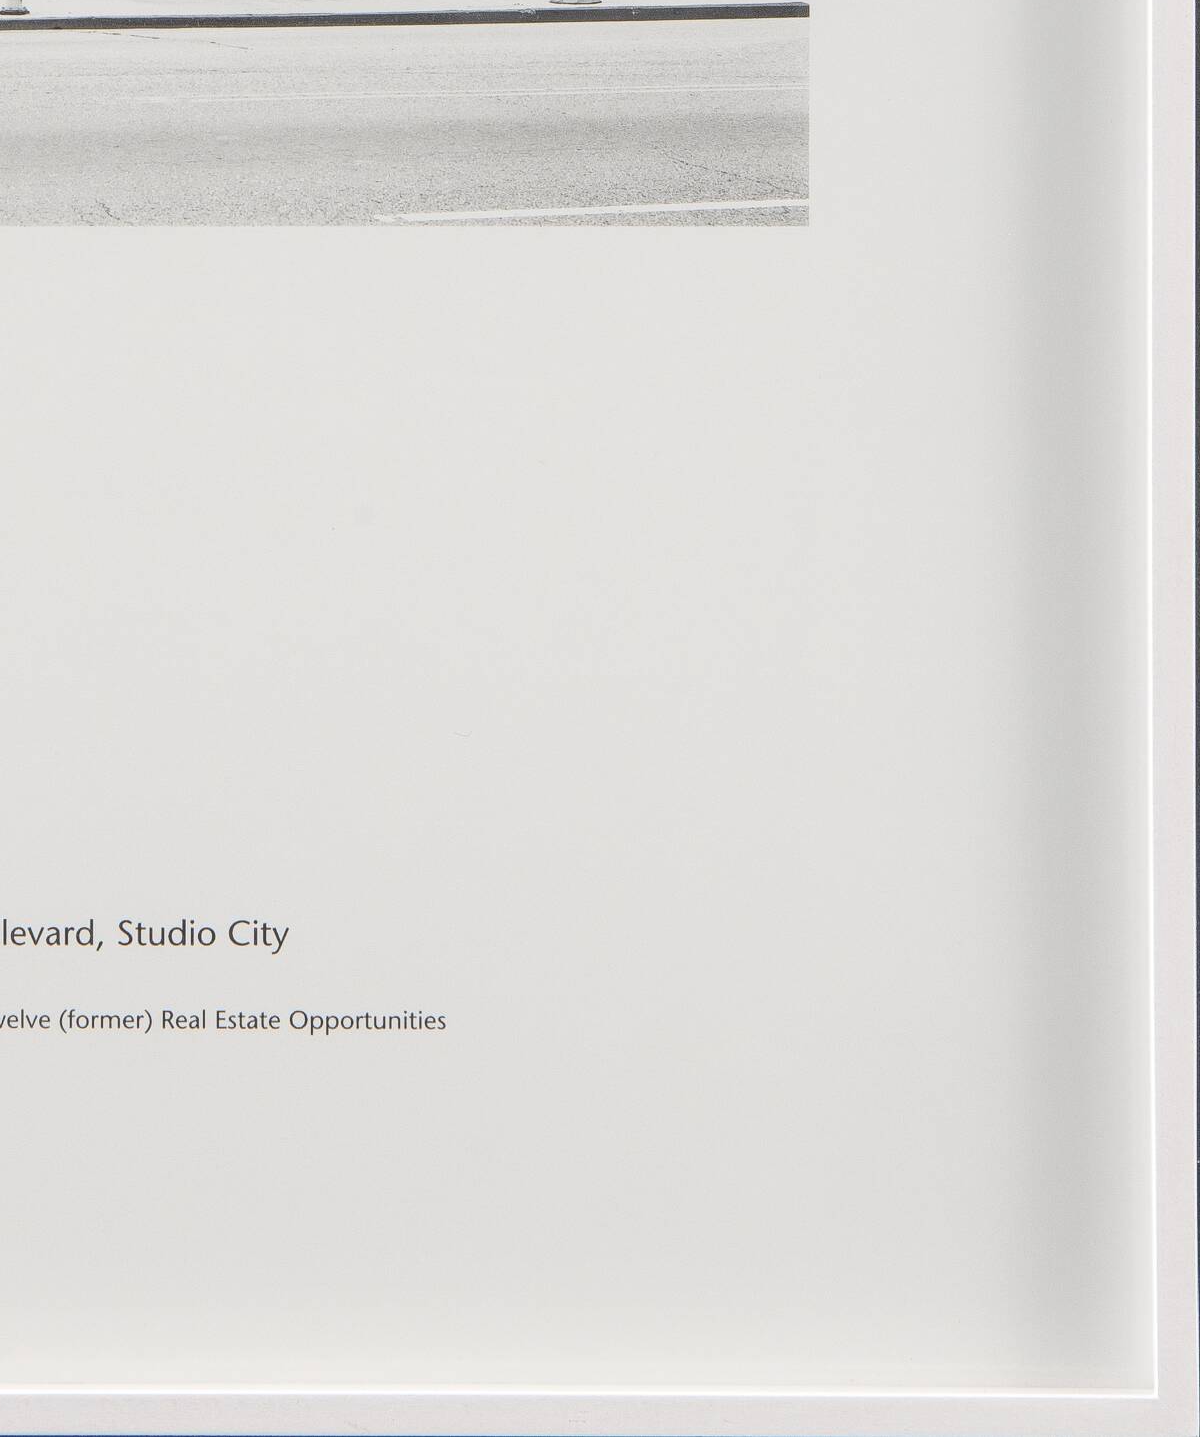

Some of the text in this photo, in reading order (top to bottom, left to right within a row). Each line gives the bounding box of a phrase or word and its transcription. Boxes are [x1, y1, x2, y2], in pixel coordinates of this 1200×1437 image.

[117, 918, 216, 947] Studio
[228, 919, 290, 955] City
[59, 1008, 153, 1034] (former)
[162, 1009, 206, 1030] Real
[216, 1010, 281, 1030] Estate
[289, 1010, 446, 1036] Opportunities
